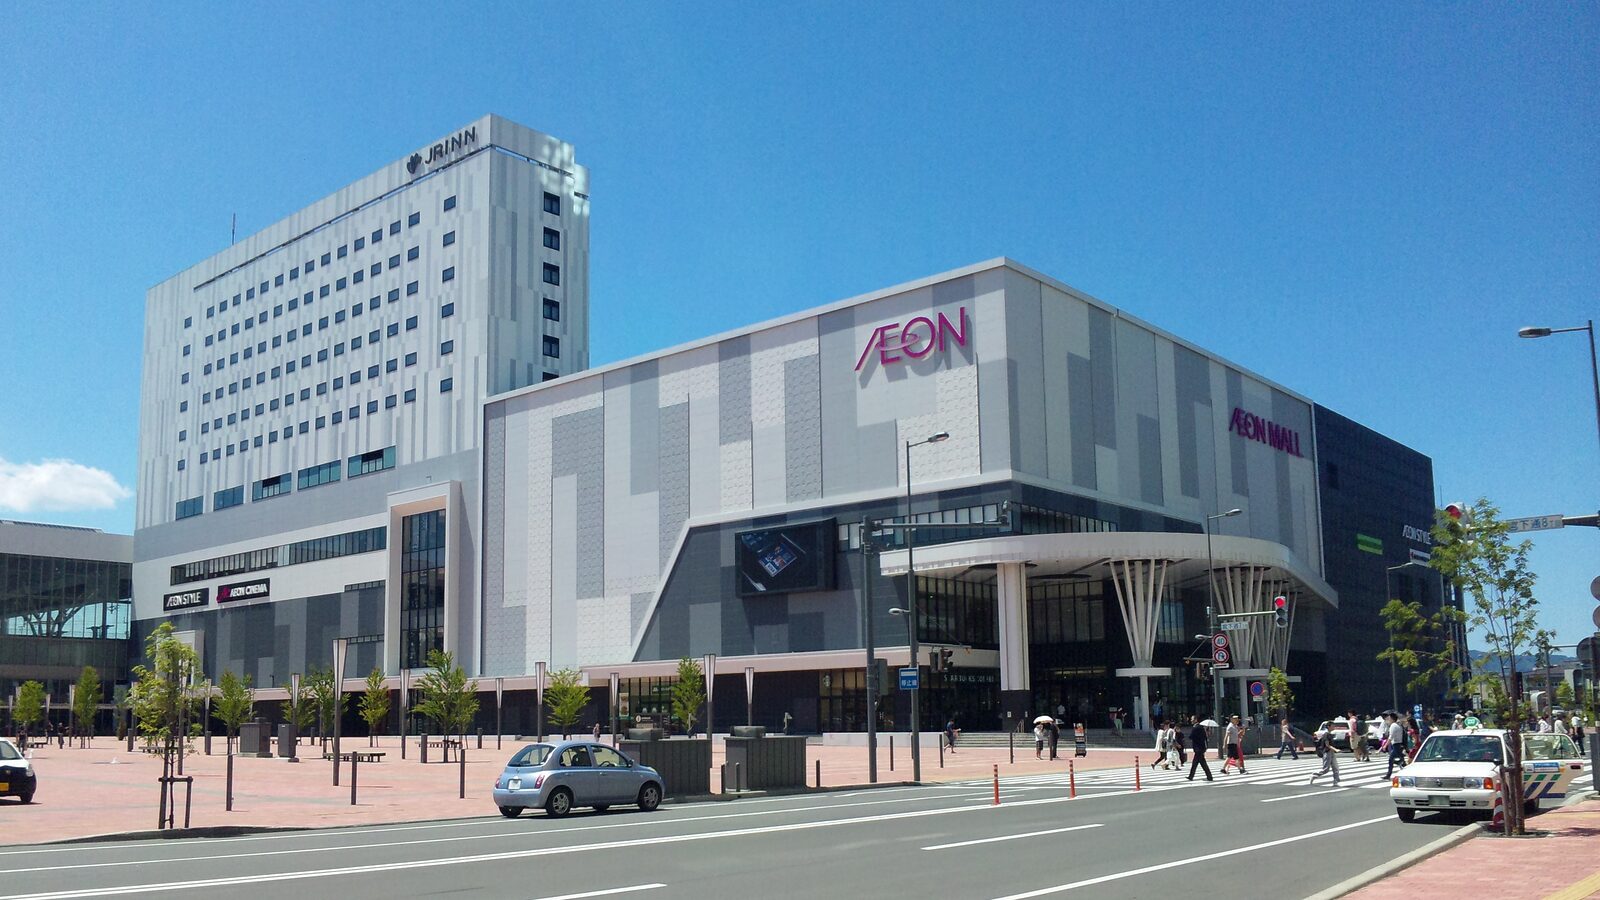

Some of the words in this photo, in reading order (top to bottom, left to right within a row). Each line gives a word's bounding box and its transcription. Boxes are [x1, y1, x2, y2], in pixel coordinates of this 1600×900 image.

[1267, 421, 1304, 458] MALL
[245, 583, 267, 596] CINEMA
[183, 591, 201, 605] STYLE
[943, 674, 976, 682] SARBUKS
